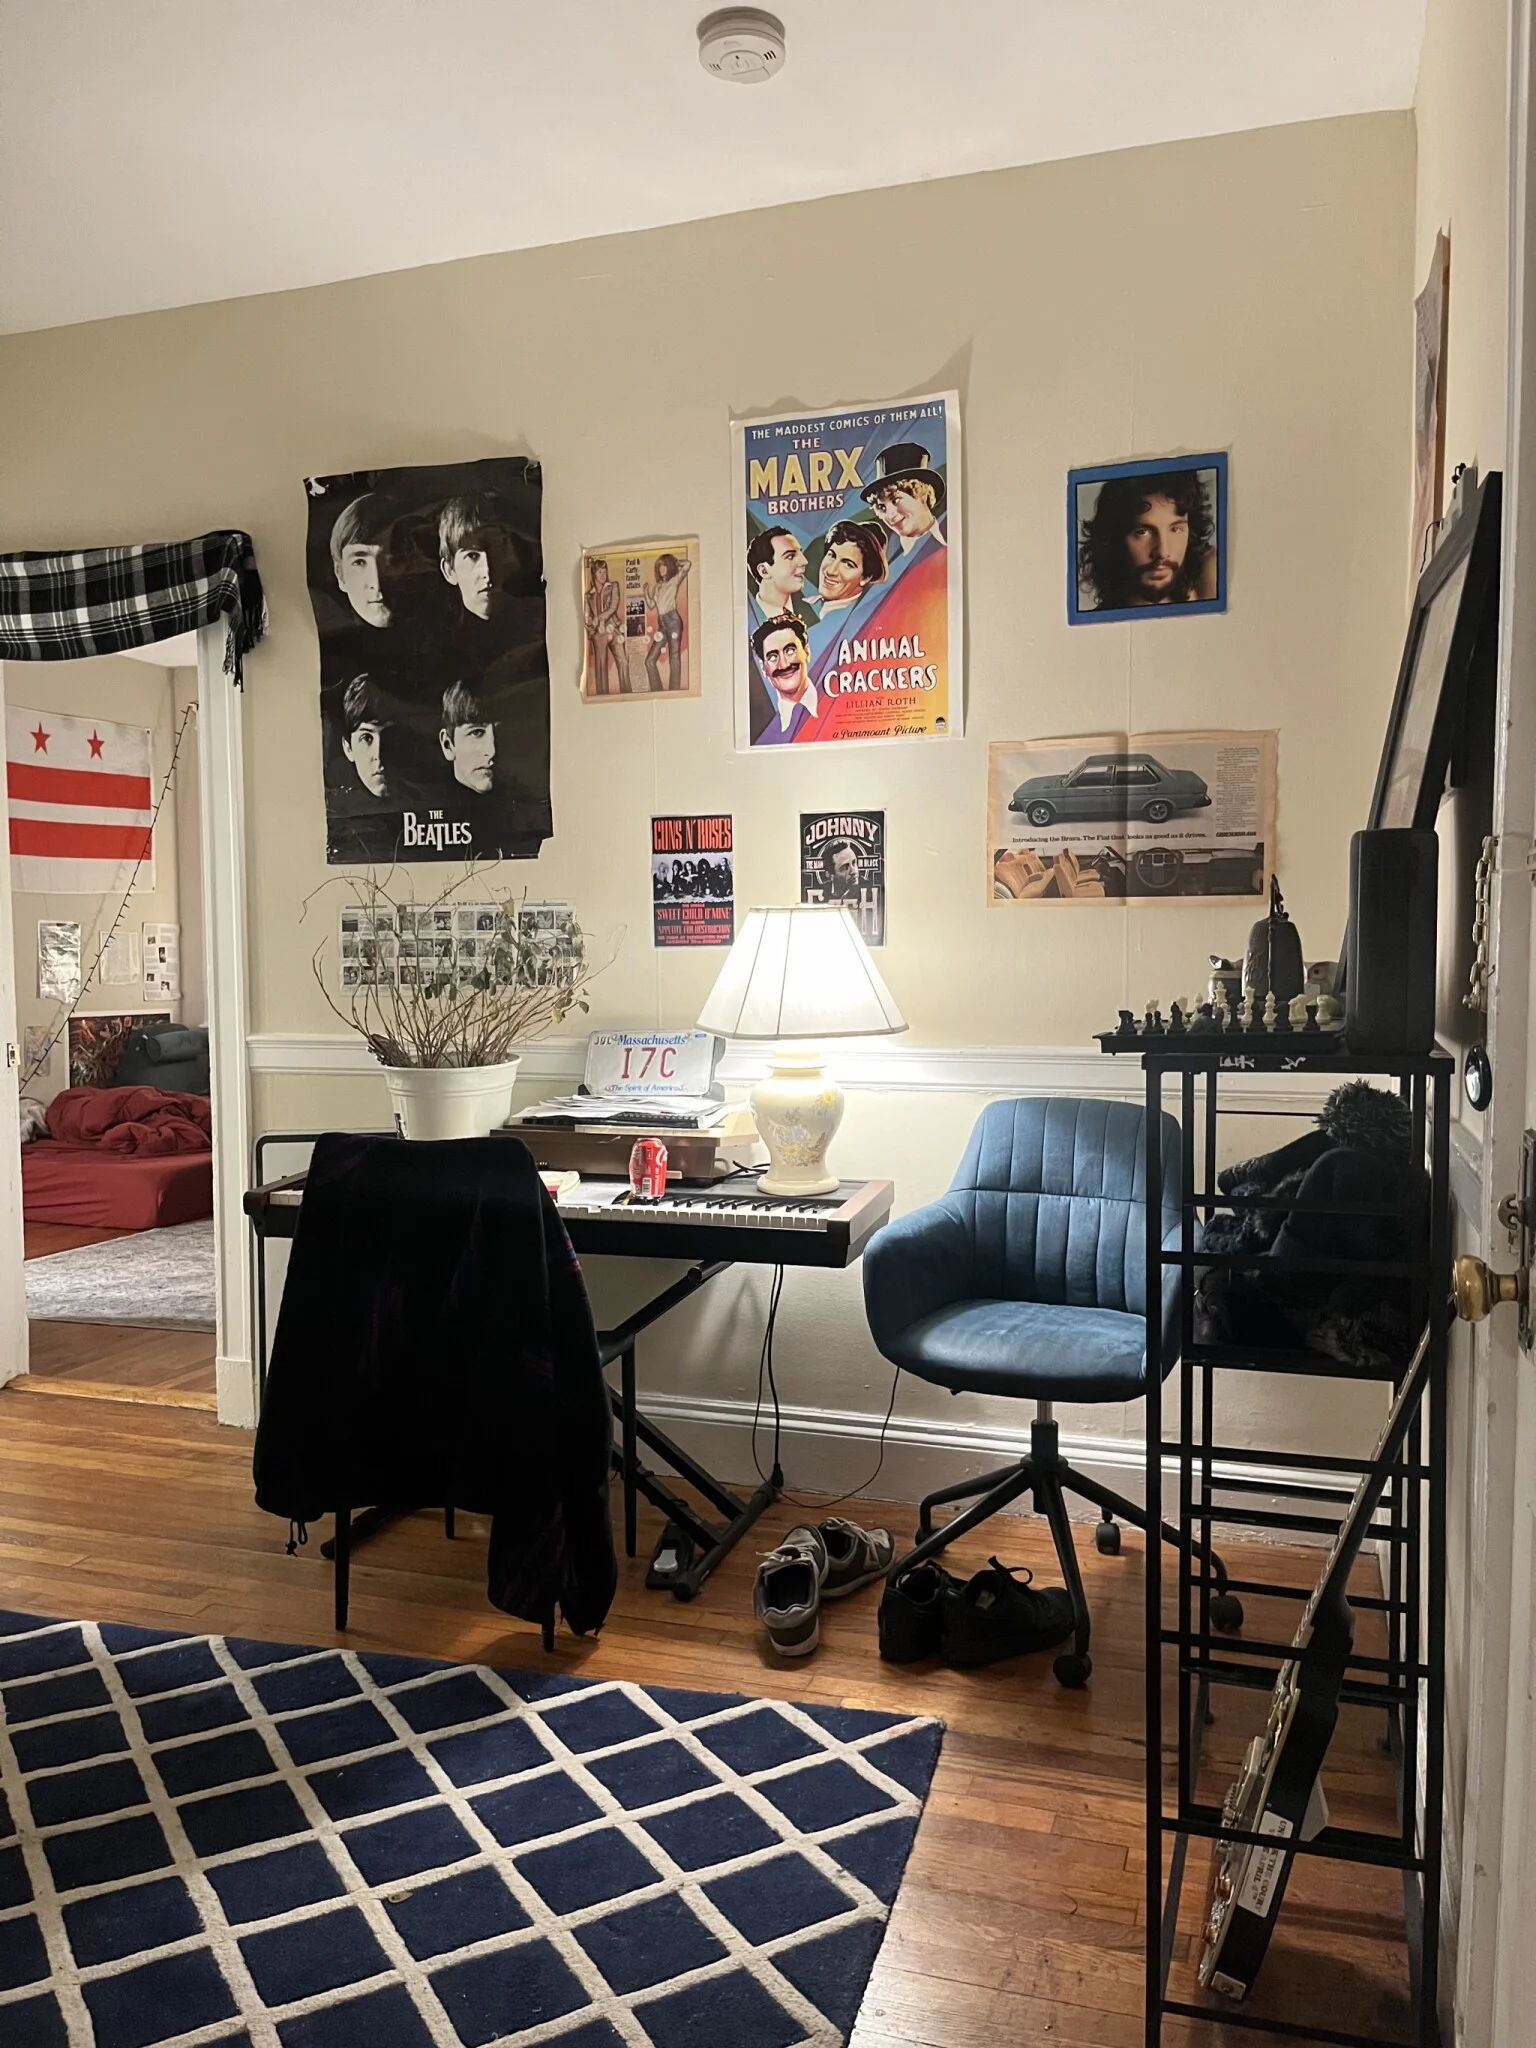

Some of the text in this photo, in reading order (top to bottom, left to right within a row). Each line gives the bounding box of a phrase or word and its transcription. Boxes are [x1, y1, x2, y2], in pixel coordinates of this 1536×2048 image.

[752, 405, 943, 440] THE MADDEST COMICS OF THEM ALL!
[792, 437, 821, 449] THE
[750, 446, 865, 499] MARX
[767, 494, 844, 515] BROTHERS
[838, 635, 926, 666] ANIMAL
[823, 664, 938, 698] CRACKERS
[846, 697, 916, 709] LILLIAN ROTH
[840, 727, 891, 740] Paramount
[893, 725, 927, 737] Picture
[428, 810, 444, 820] THE
[403, 812, 472, 851] BEATLES
[654, 820, 683, 850] GUNS
[698, 818, 732, 849] ROSES
[805, 817, 879, 845] JOHNNY
[616, 1034, 686, 1046] Massachusetts
[611, 1084, 678, 1093] The Spirit of America
